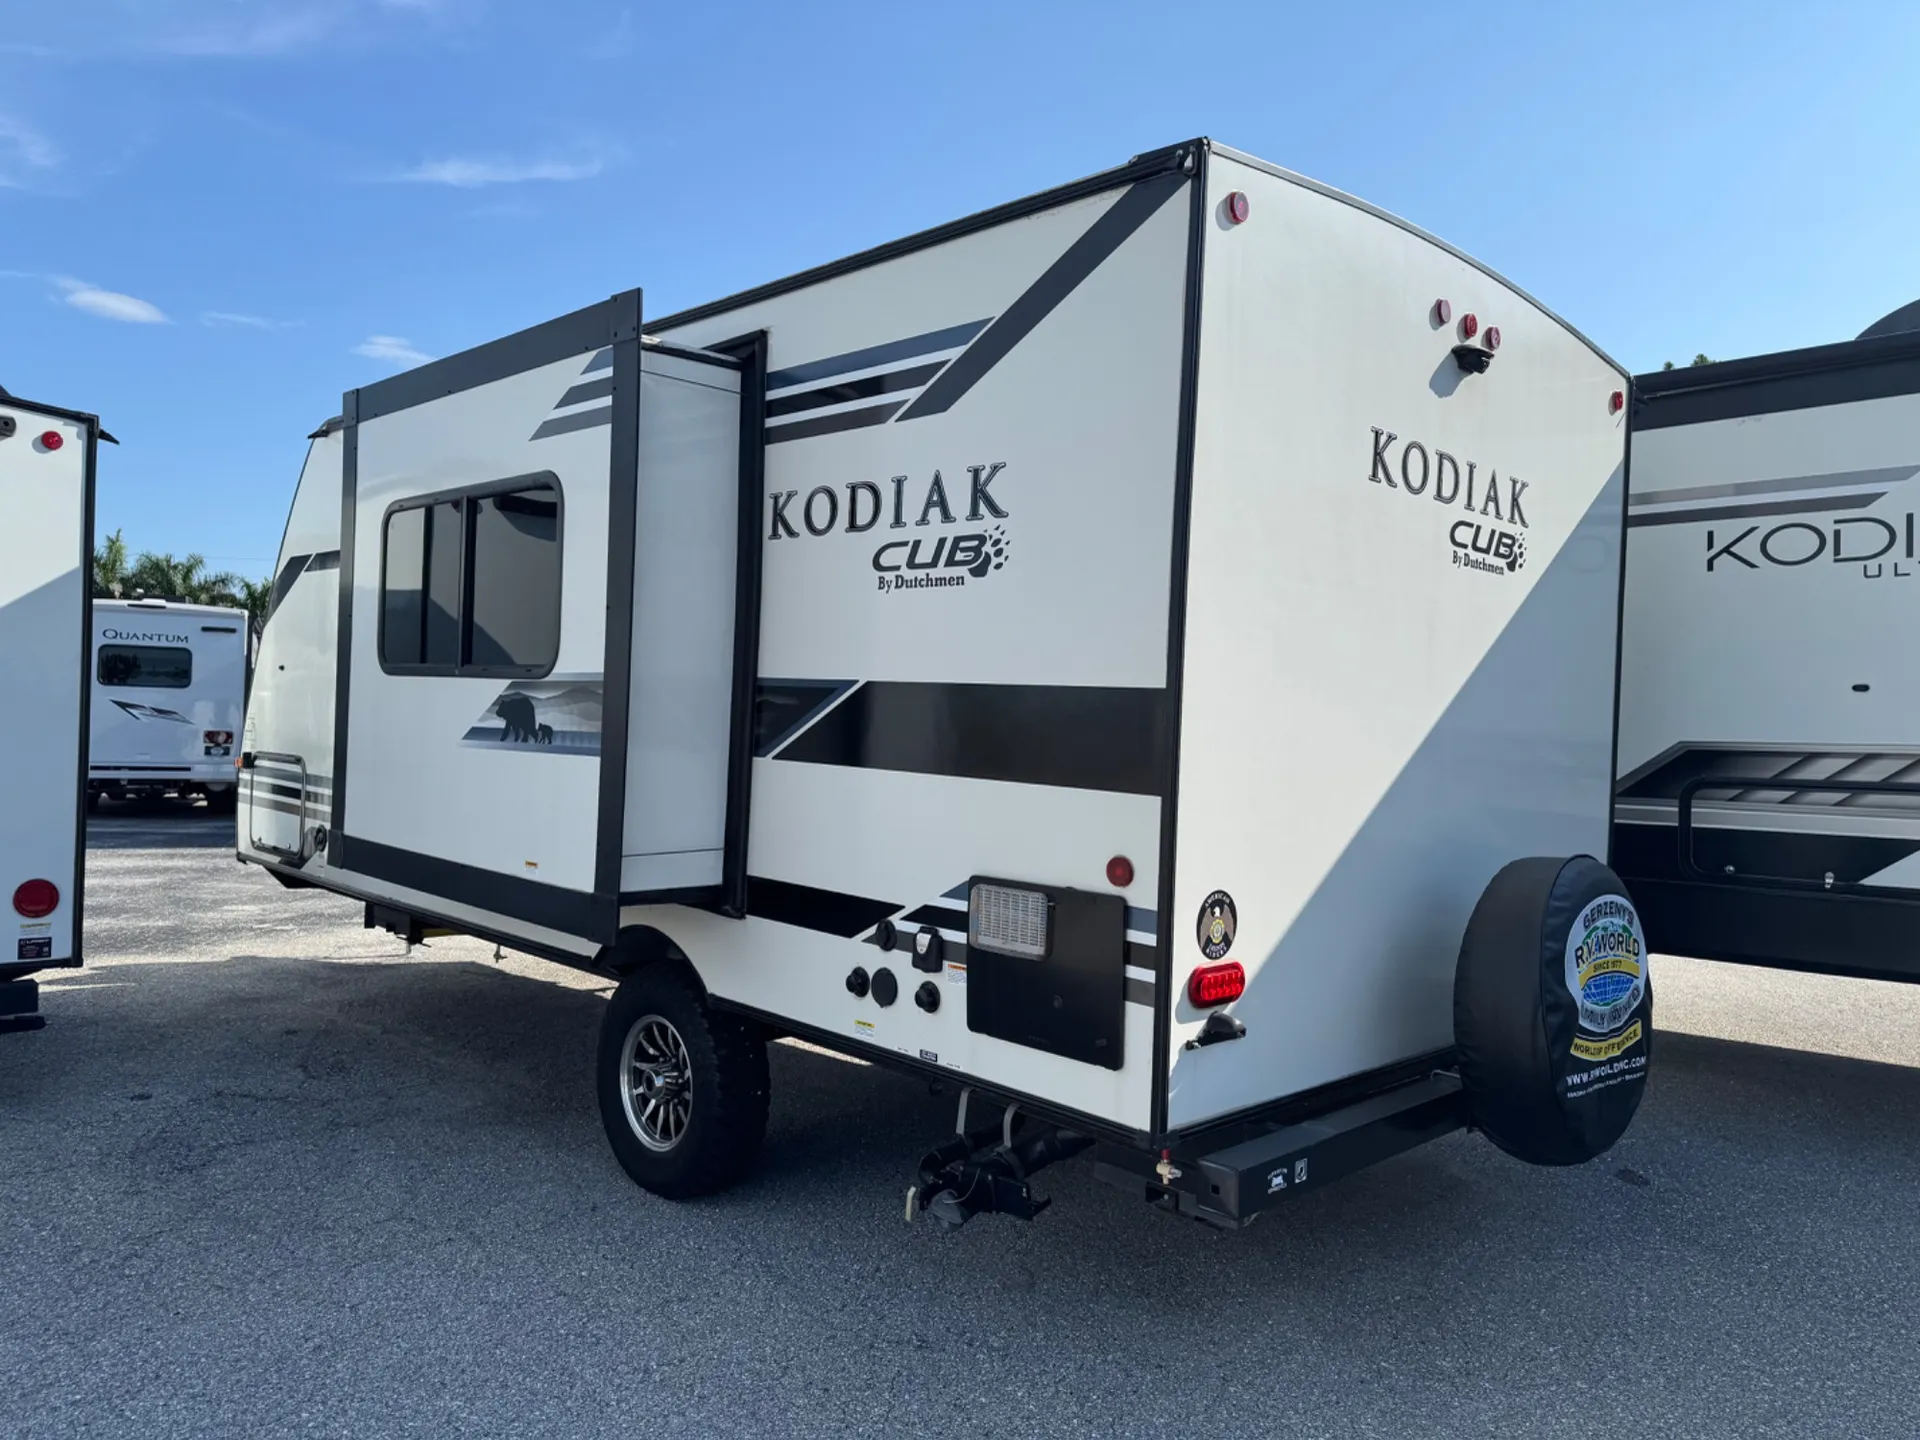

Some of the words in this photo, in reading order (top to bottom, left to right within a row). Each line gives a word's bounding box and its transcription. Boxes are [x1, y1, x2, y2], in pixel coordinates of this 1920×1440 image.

[1368, 426, 1529, 529] KODIAK
[768, 461, 1009, 540] KODIAK
[872, 533, 988, 572] CUB
[1449, 520, 1517, 560] CUB
[1452, 550, 1463, 568] By
[1463, 553, 1504, 576] Dutchmen
[1863, 561, 1920, 579] UL
[877, 575, 893, 593] By
[894, 573, 965, 590] Dutchmen
